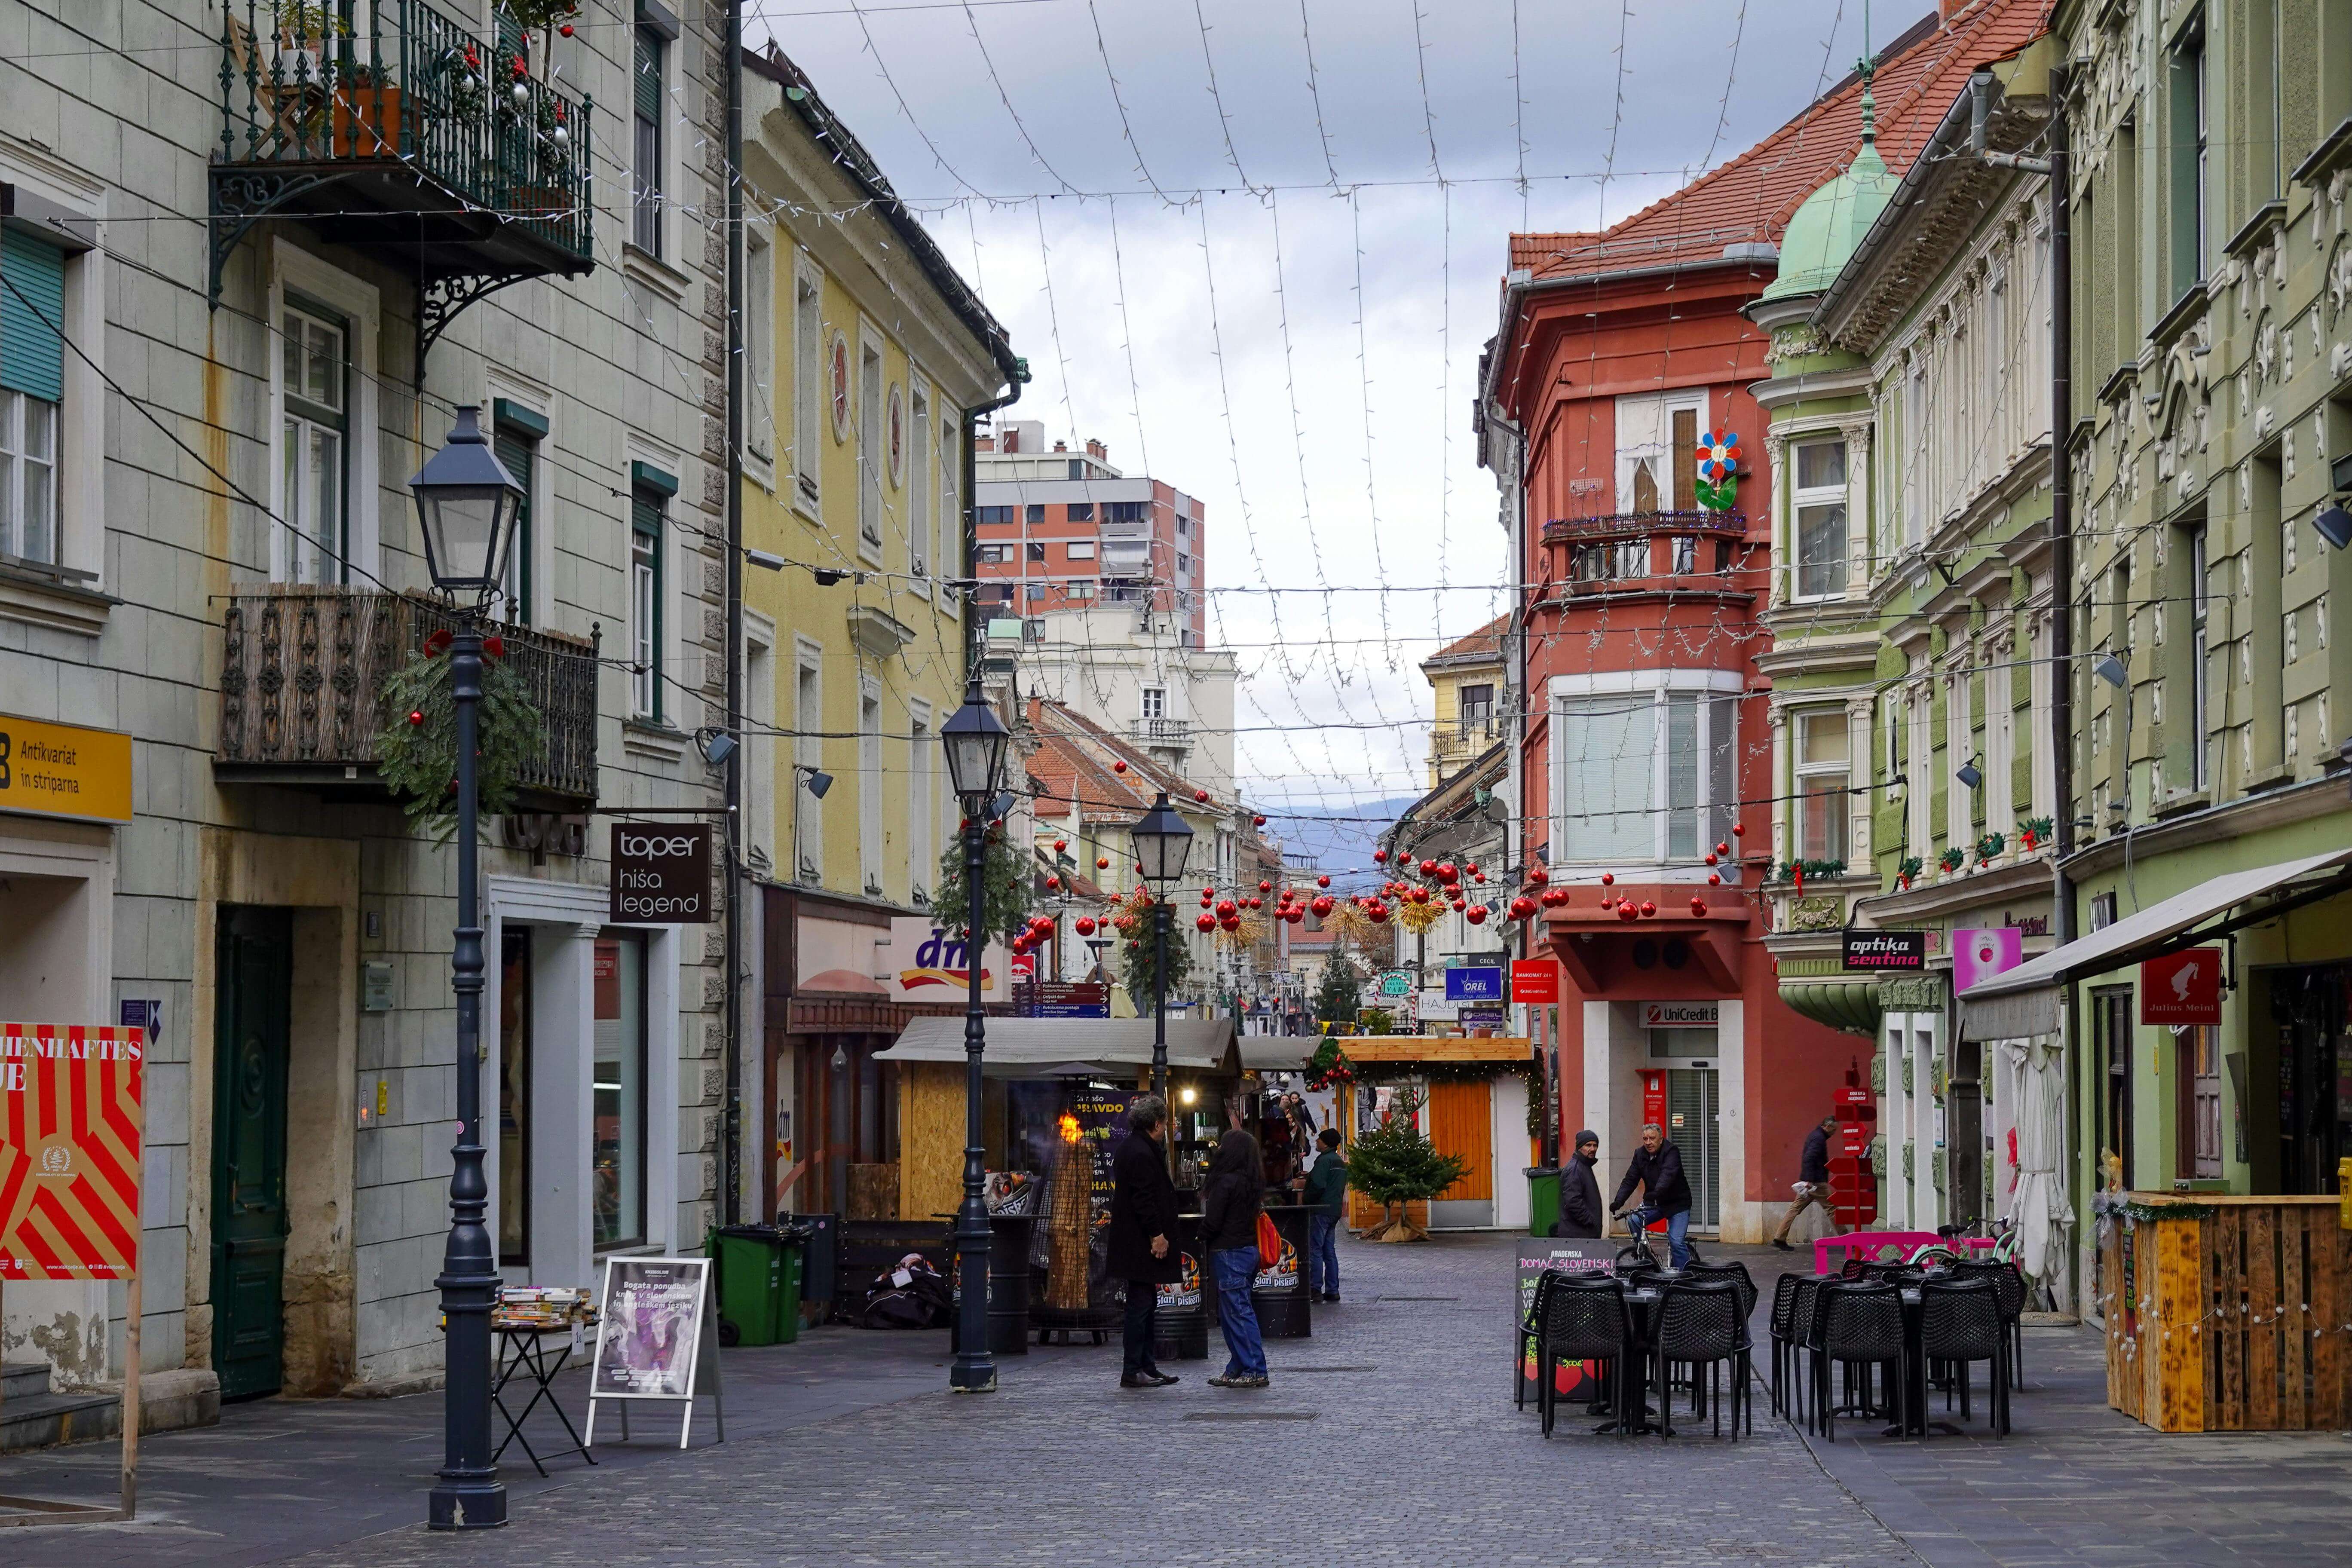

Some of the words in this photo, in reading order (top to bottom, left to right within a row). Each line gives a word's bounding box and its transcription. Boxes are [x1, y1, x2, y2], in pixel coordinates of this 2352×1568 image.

[21, 741, 76, 765] Antikvariat
[21, 768, 31, 788] in
[34, 771, 80, 795] striparna
[621, 832, 699, 861] toper
[620, 868, 662, 888] hiša
[619, 892, 698, 917] legend
[1850, 937, 1909, 954] optika
[1848, 952, 1919, 965] sentina
[1465, 983, 1487, 991] OREL
[1664, 1008, 1709, 1020] UniCredit
[778, 1099, 790, 1139] dm
[1556, 1259, 1614, 1269] SLOVENSKI
[624, 1281, 651, 1290] Bogata
[1255, 1276, 1272, 1286] Stari
[616, 1290, 636, 1300] knjig
[623, 1301, 665, 1309] angleškem
[666, 1302, 692, 1311] jeziku
